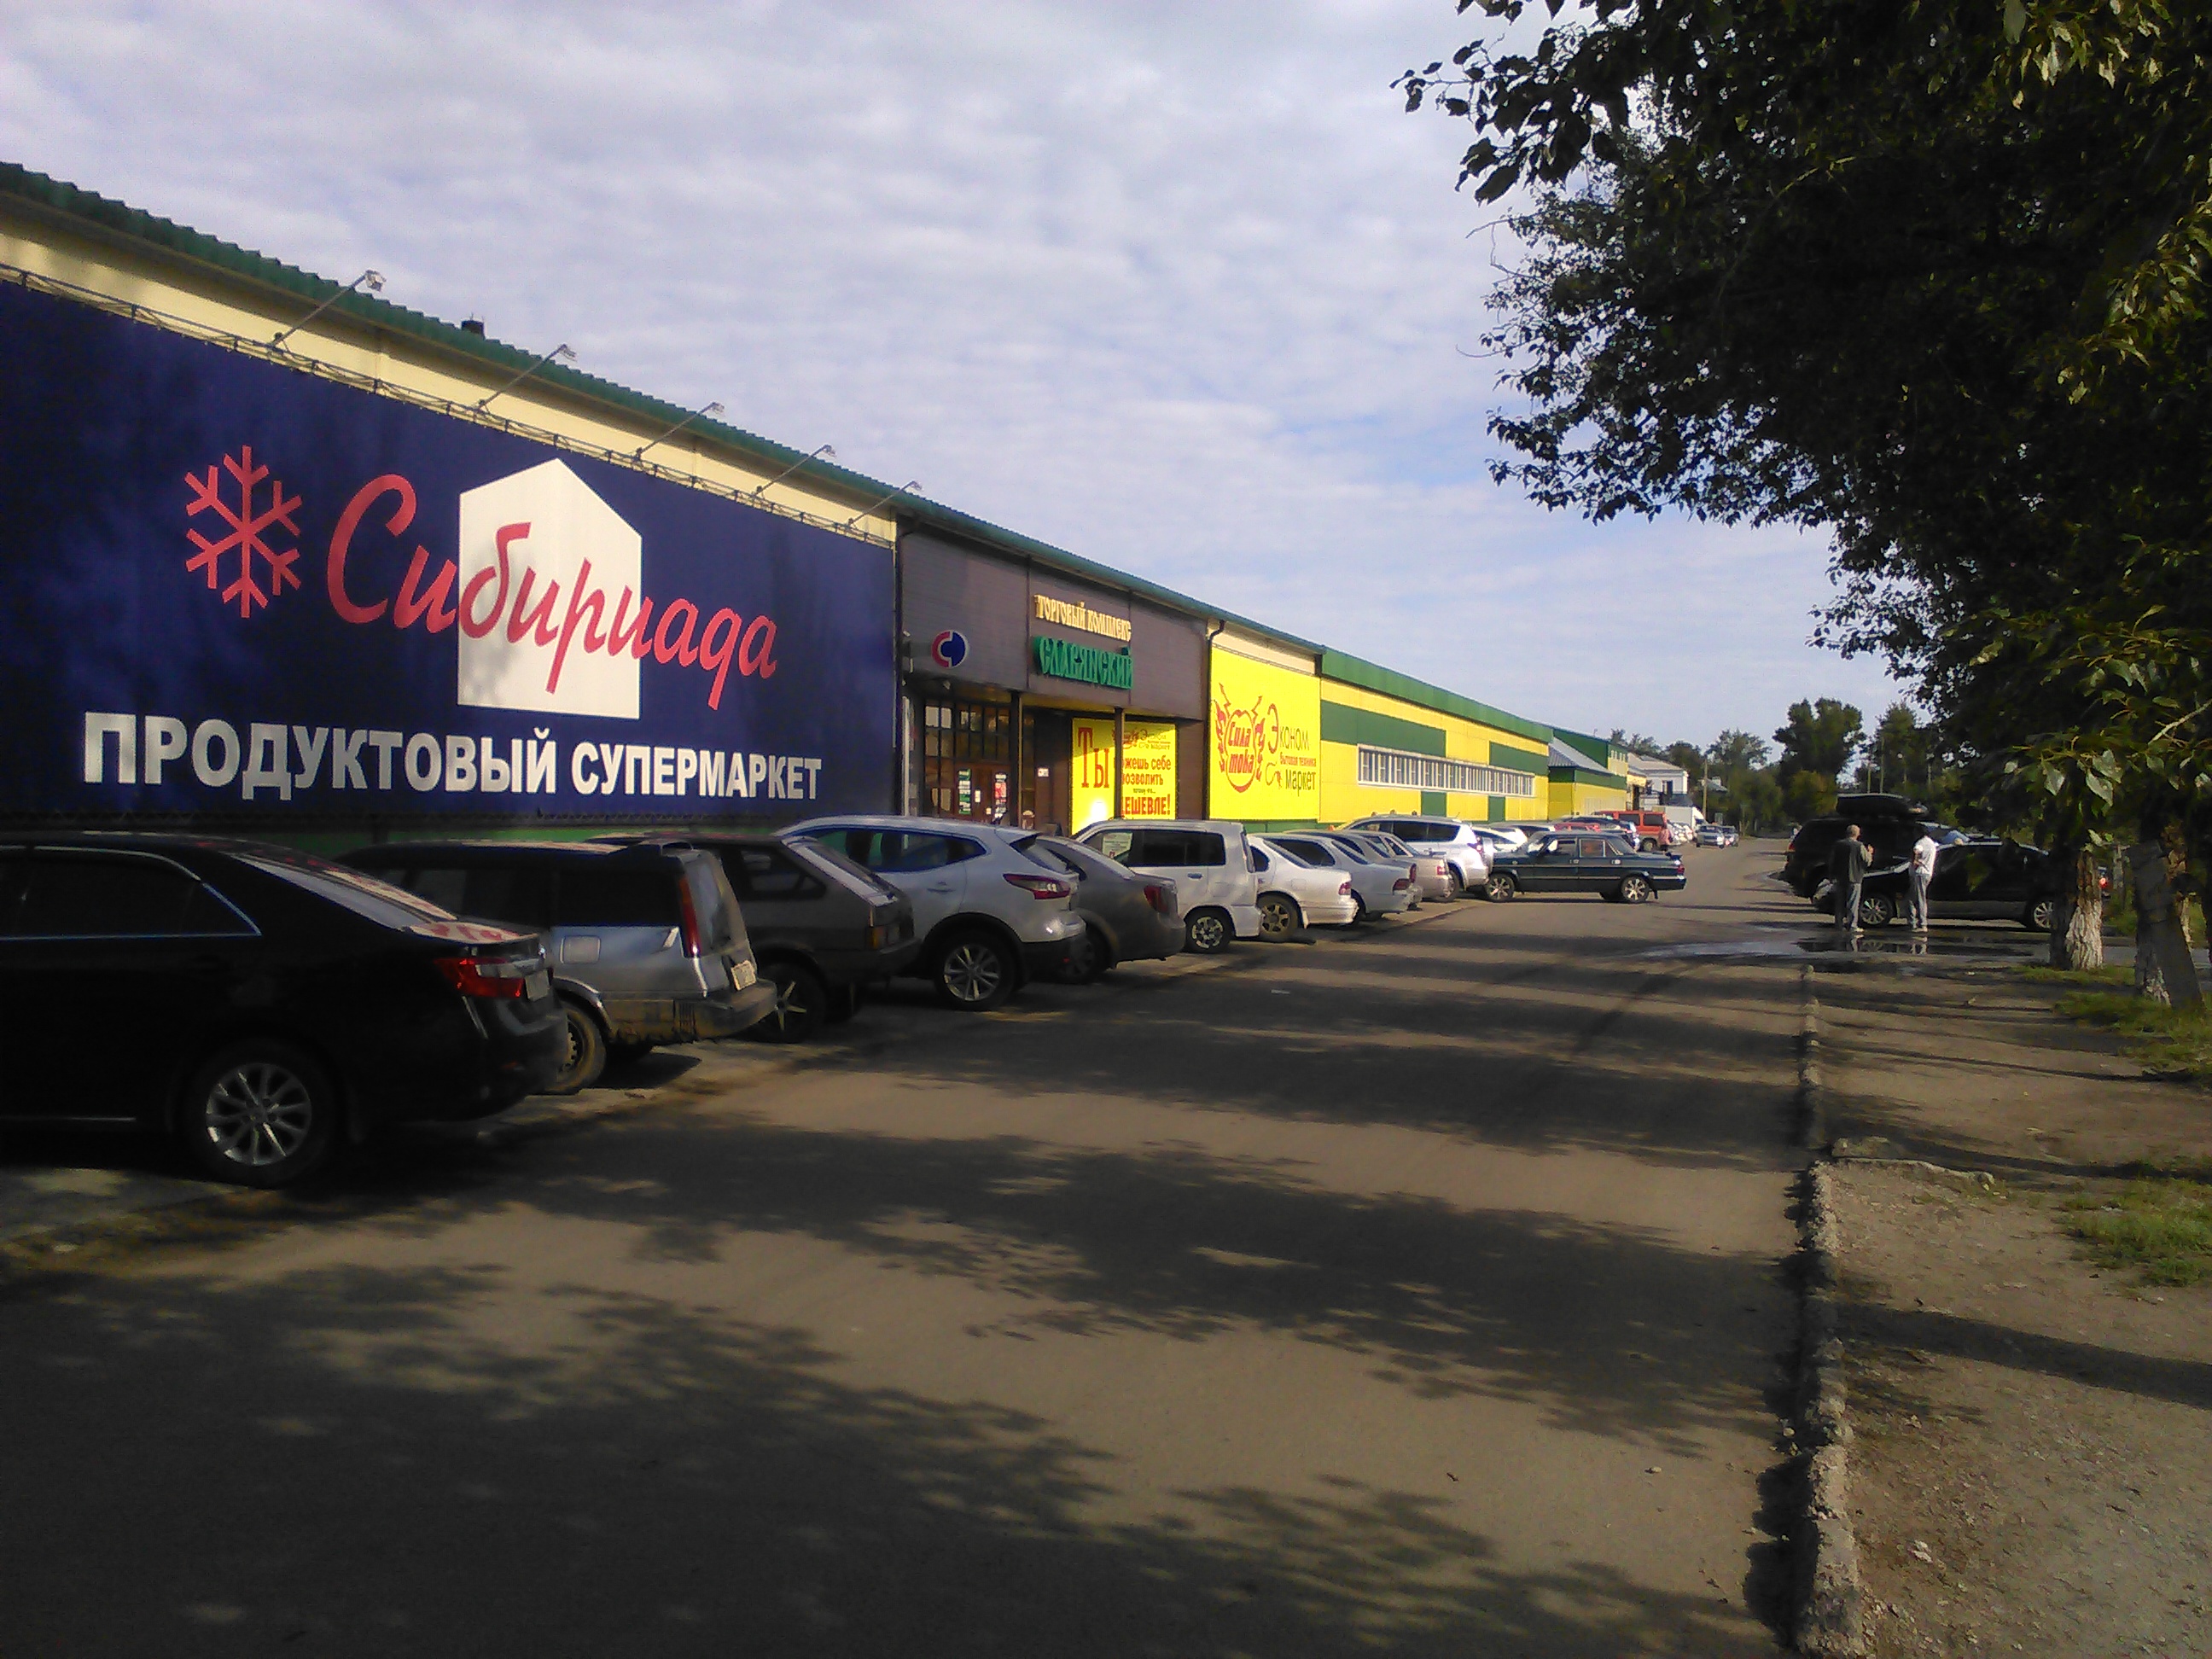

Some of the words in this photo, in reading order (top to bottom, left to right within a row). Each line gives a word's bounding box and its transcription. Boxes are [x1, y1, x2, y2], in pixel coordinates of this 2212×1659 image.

[327, 474, 778, 710] Сибириада
[84, 711, 557, 800] ПРОДУКТОВЫЙ
[571, 742, 823, 800] СУПЕРМАРКЕТ
[1228, 722, 1251, 748] Сила
[1267, 703, 1310, 754] Эконом
[1077, 727, 1109, 788] Ты
[1151, 755, 1171, 771] себе
